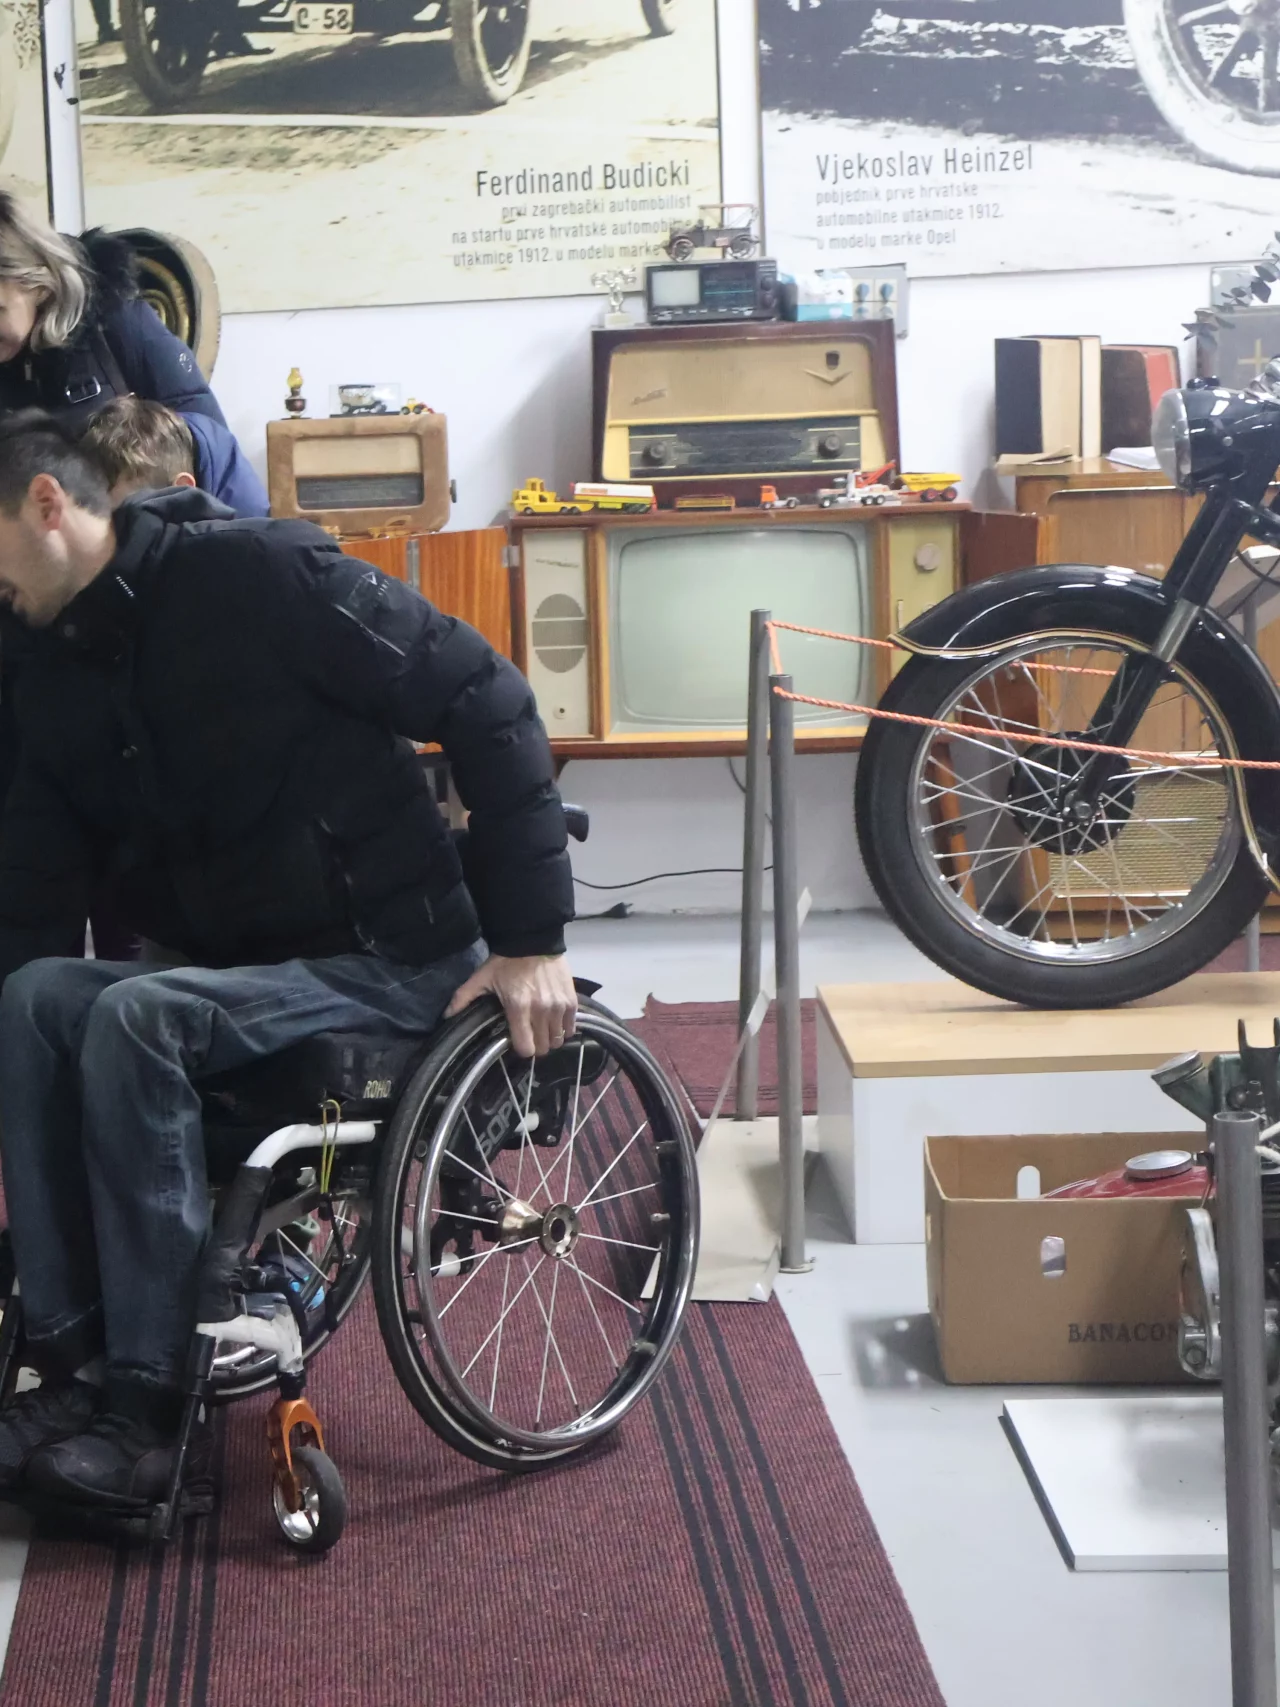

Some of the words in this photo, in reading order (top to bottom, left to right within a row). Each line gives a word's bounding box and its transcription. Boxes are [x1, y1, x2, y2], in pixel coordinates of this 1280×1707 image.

[816, 150, 933, 184] Vjekoslav
[944, 144, 1033, 174] Heinzel
[477, 165, 593, 197] Ferdinand
[603, 159, 690, 190] Budicki
[816, 187, 881, 206] pobjednik
[886, 186, 916, 203] prve
[920, 181, 979, 198] hrvatske
[532, 198, 605, 219] zagrebački
[609, 195, 691, 213] automobilist
[816, 208, 898, 228] automobilne
[902, 206, 964, 223] utakmice
[969, 202, 1005, 220] 1912.
[452, 230, 468, 244] na
[472, 227, 512, 243] startu
[517, 227, 545, 245] prve
[549, 221, 607, 240] hrvatske
[817, 238, 824, 250] u
[829, 233, 876, 250] modelu
[881, 230, 923, 247] marke
[927, 228, 956, 246] Opel
[454, 248, 514, 267] utakmice
[556, 250, 563, 262] u
[568, 243, 614, 261] modelu
[619, 241, 660, 257] marke
